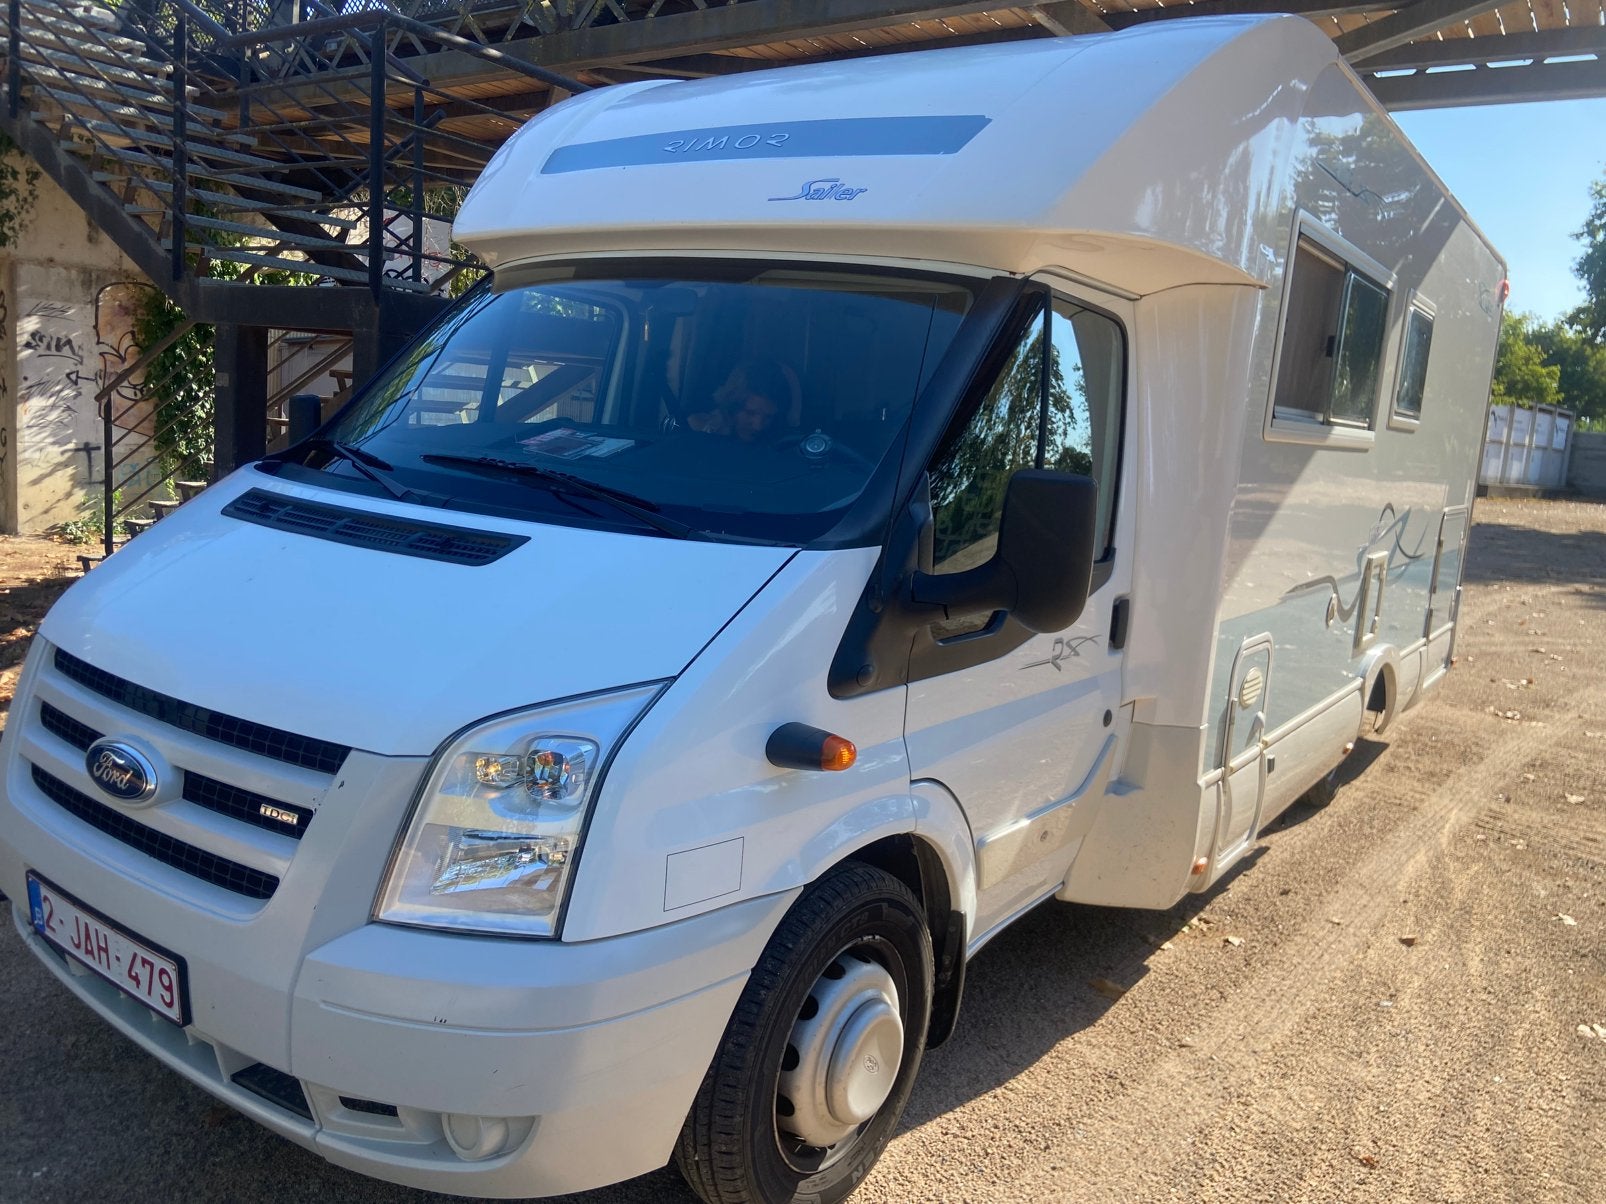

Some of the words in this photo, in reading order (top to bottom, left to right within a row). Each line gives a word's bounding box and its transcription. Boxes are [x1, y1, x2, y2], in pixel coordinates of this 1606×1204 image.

[767, 177, 869, 202] Sailer
[92, 750, 134, 791] Ford
[260, 804, 297, 824] TDCi
[42, 894, 175, 1009] 2-JAH-479
